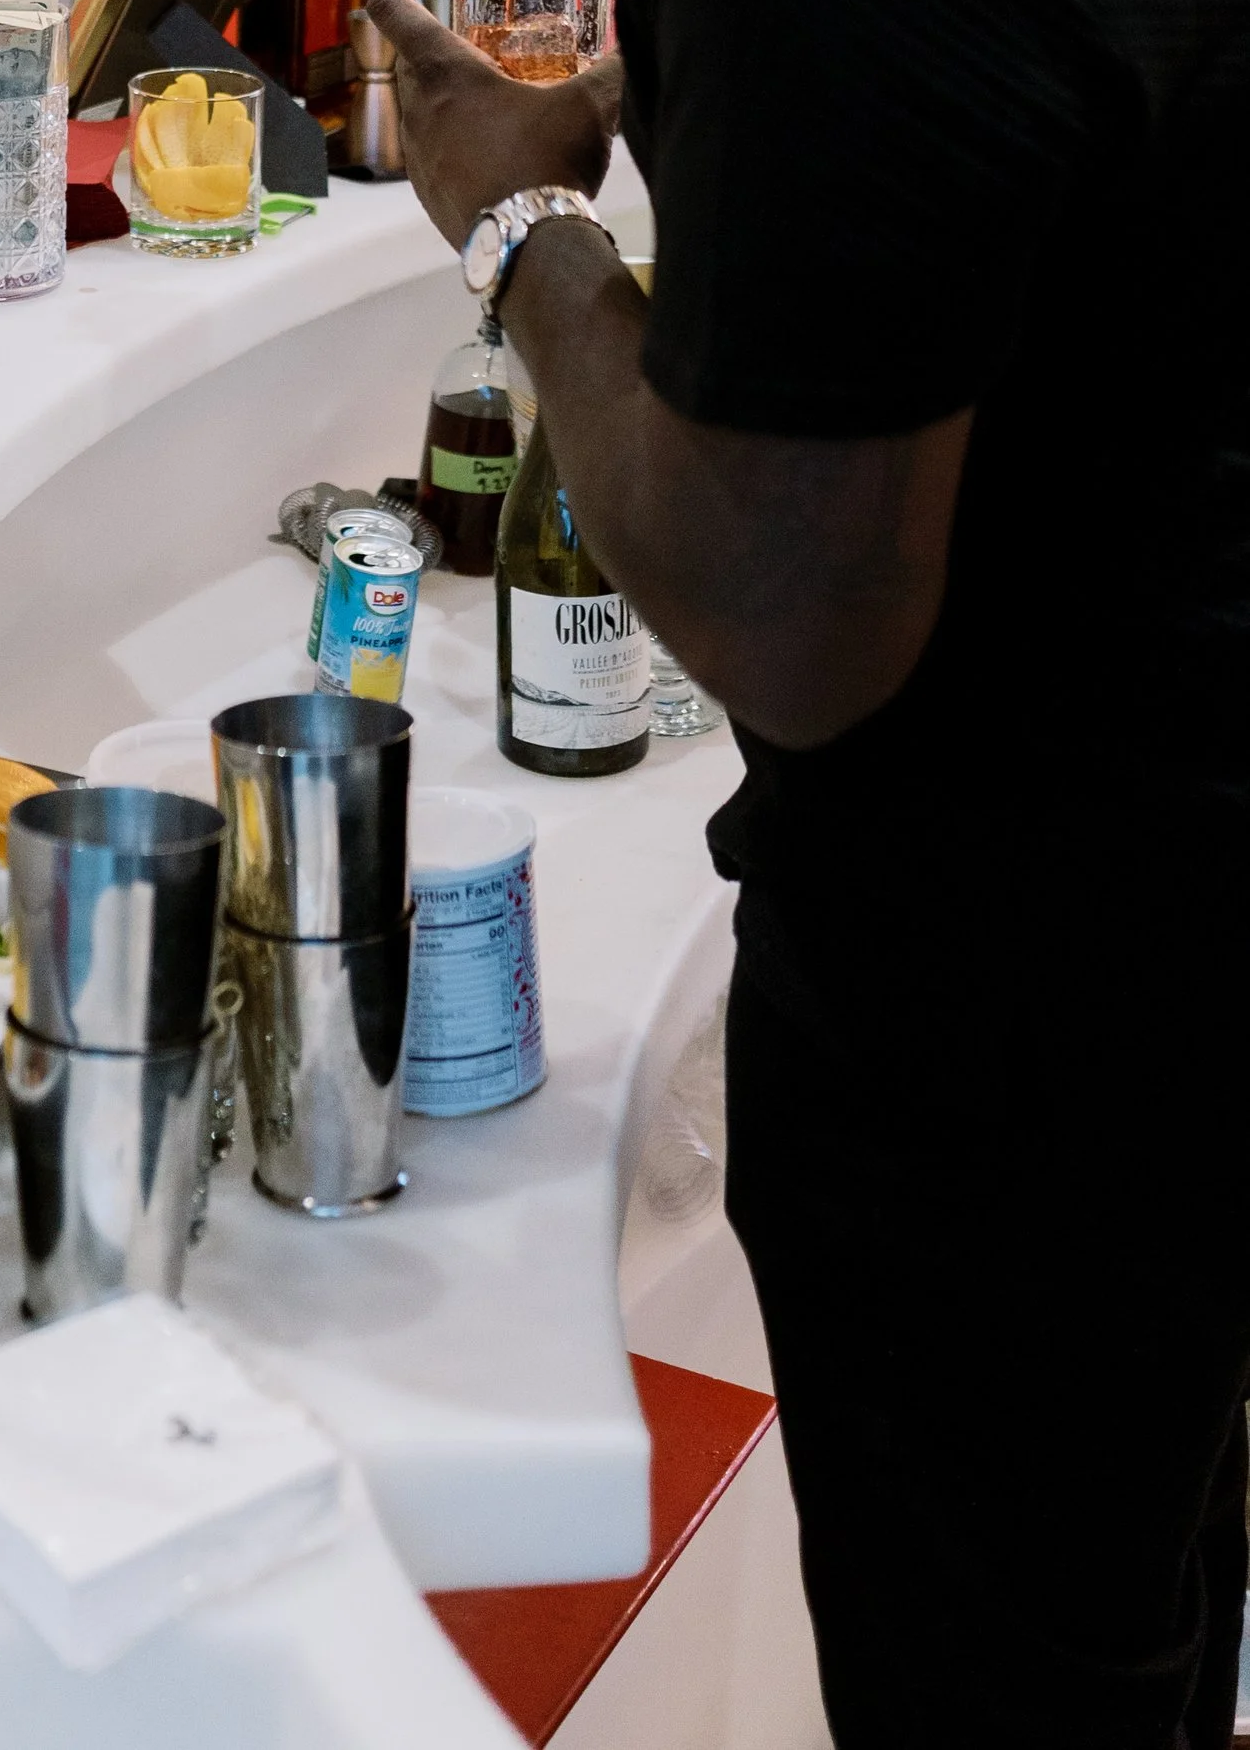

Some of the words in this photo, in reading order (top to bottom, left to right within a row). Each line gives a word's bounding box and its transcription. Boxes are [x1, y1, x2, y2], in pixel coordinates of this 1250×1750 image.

[373, 591, 405, 603] Dole
[353, 616, 384, 634] 100%
[555, 599, 642, 645] GROSJE
[465, 881, 503, 901] Facts
